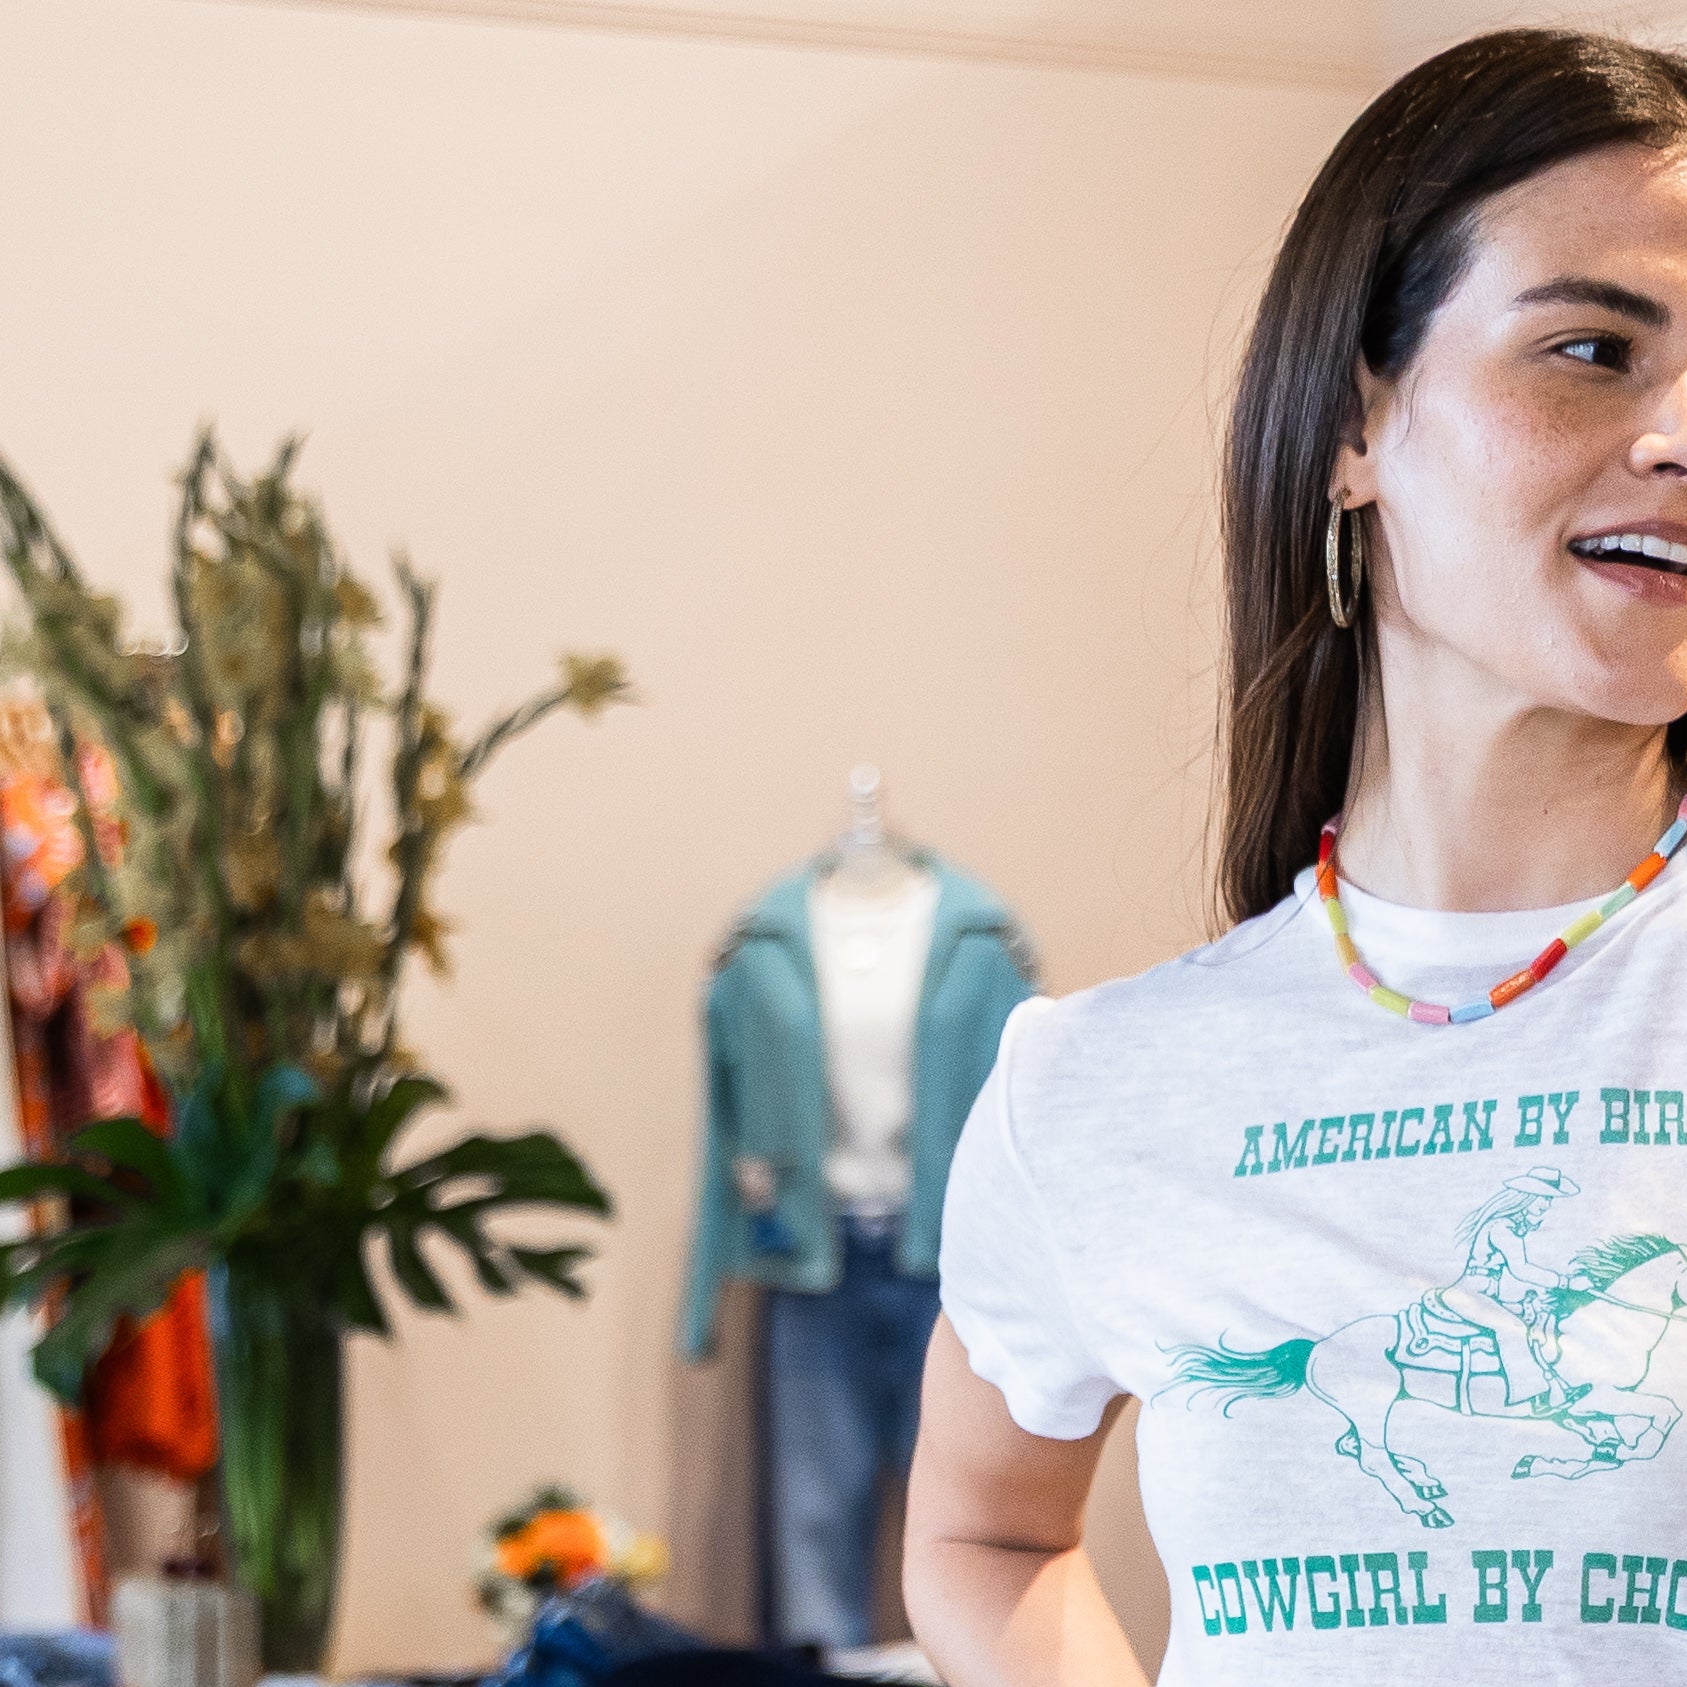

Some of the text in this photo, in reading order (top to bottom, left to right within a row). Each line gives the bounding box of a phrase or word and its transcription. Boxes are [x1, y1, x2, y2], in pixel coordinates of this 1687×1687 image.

[1232, 1097, 1499, 1178] AMERICAN
[1513, 1089, 1581, 1149] BY
[1190, 1549, 1449, 1638] COWGIRL
[1470, 1548, 1555, 1625] BY
